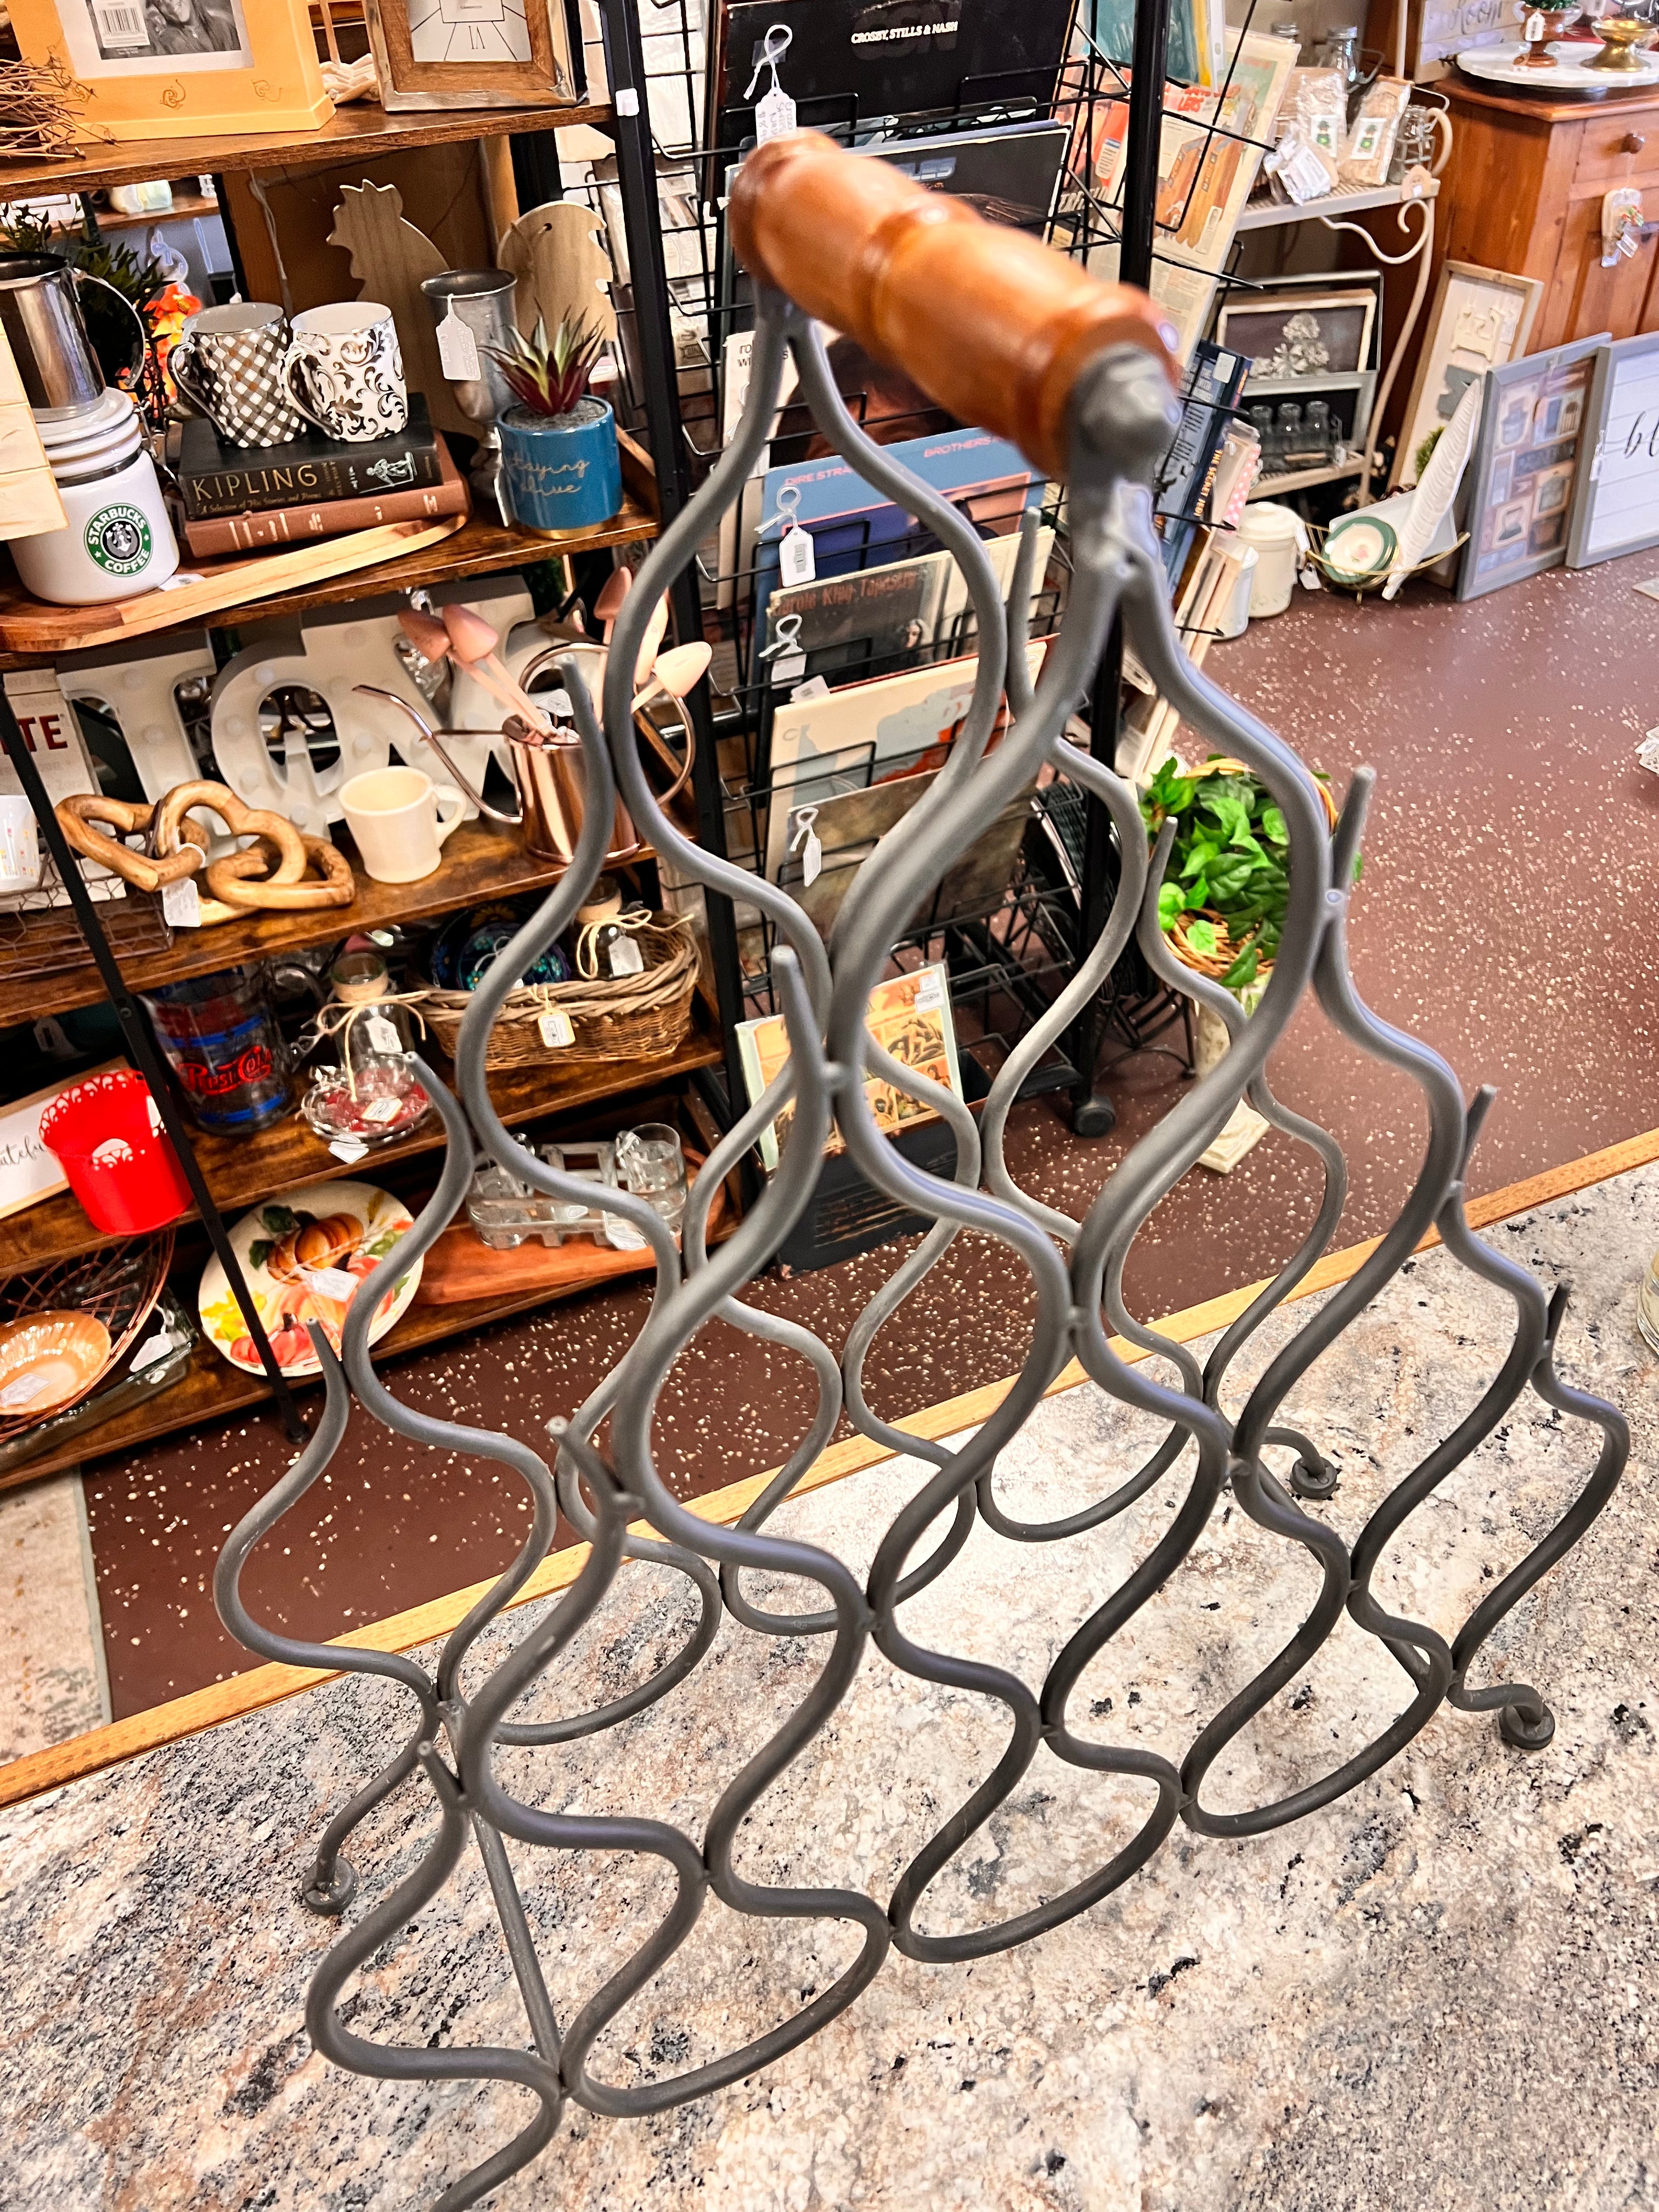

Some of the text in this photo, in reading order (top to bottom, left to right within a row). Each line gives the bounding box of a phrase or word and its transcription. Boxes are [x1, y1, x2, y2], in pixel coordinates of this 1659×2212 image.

[851, 21, 958, 44] CROSBY, STILLS & NASH
[816, 467, 852, 481] STRA
[923, 437, 991, 458] BROTHERS
[192, 464, 318, 501] KIPLING
[88, 507, 146, 545] STARBUCKS
[104, 549, 150, 573] COFFEE
[0, 715, 68, 755] TE
